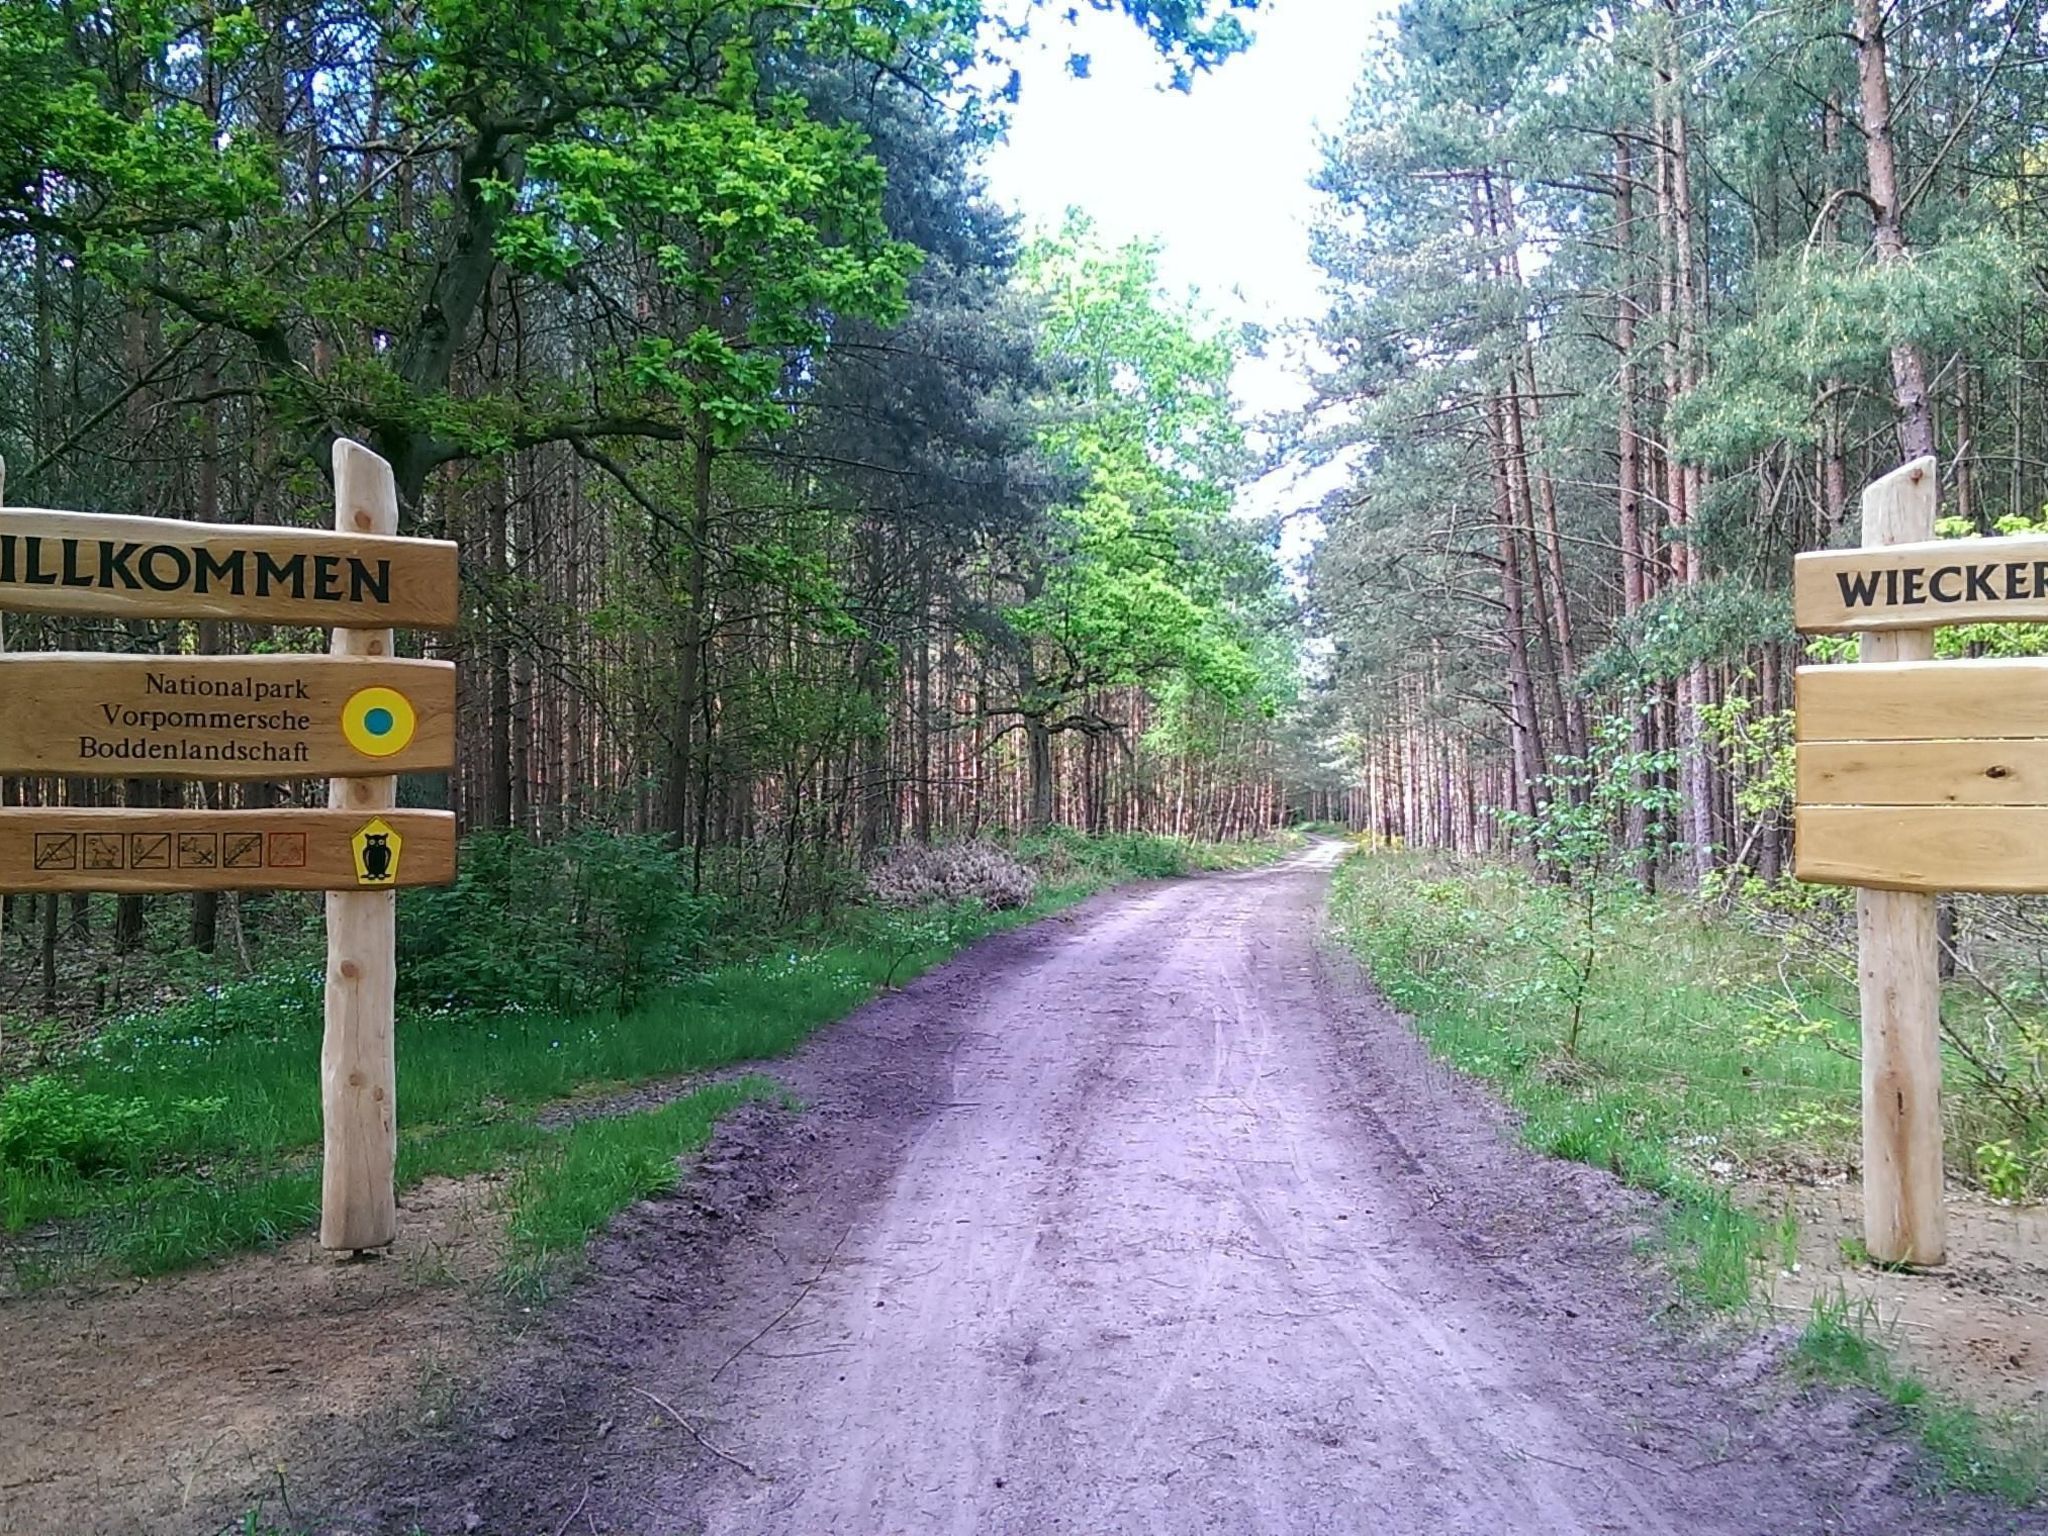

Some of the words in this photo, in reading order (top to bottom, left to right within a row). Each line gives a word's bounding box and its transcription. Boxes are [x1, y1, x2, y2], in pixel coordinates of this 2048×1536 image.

[145, 672, 310, 700] Nationalpark
[102, 703, 310, 731] Vorpommersche
[79, 736, 310, 762] Boddenlandschaft
